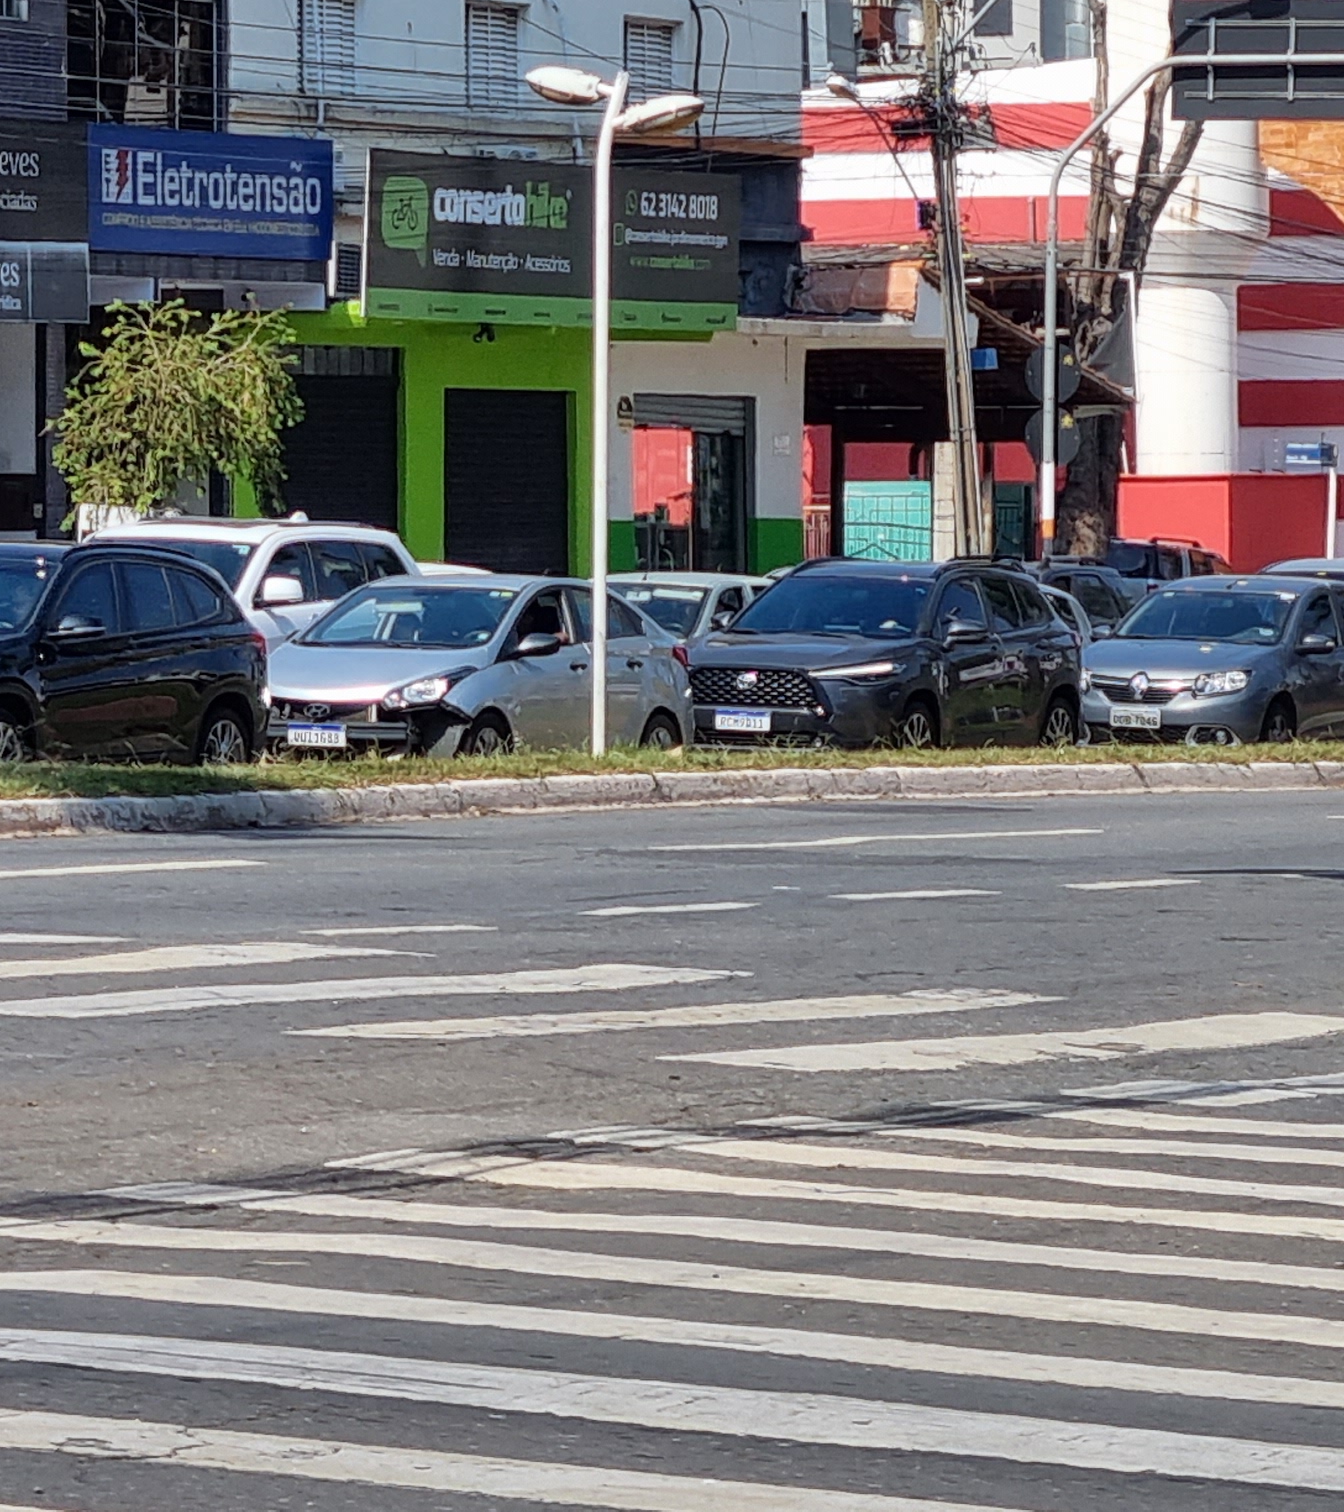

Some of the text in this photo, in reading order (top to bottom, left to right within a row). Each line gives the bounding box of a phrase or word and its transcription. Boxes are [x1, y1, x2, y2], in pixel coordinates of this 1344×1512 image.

[137, 150, 321, 215] Eletrotensão
[640, 191, 718, 220] 62 3142 8018
[433, 248, 460, 267] Venda
